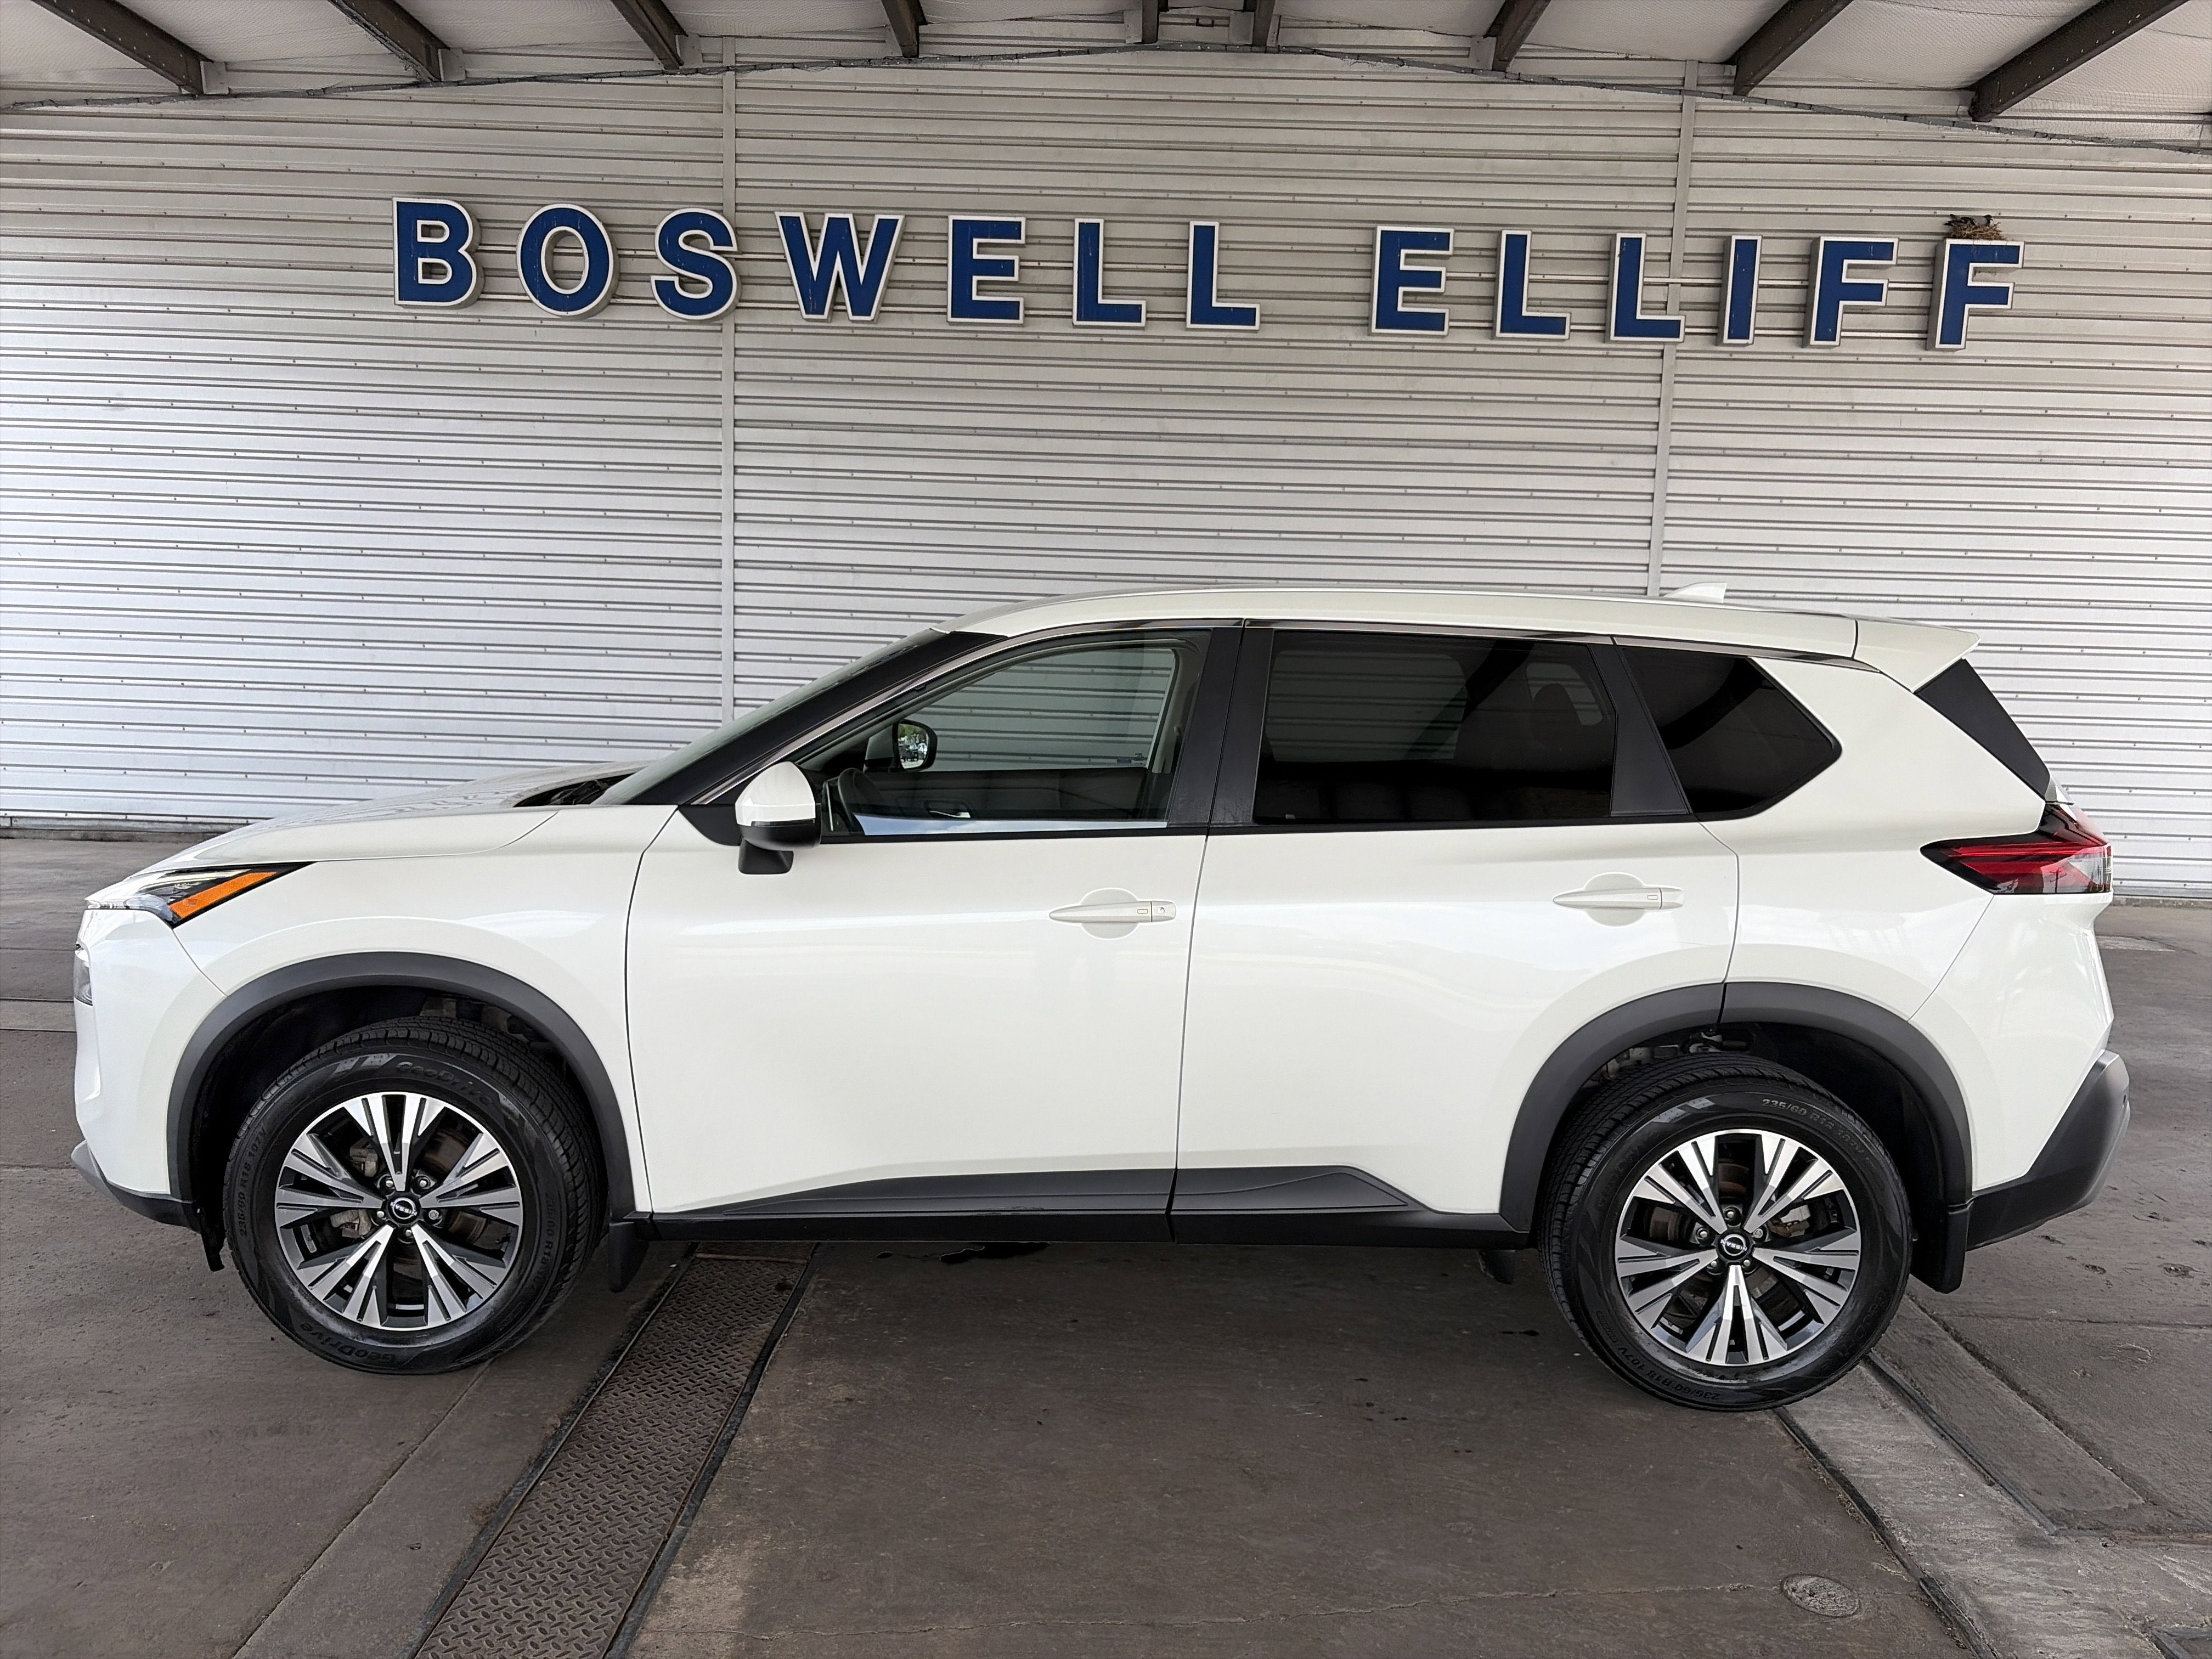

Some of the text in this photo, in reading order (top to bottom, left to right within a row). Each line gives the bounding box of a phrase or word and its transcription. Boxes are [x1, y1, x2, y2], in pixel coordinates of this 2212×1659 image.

[393, 197, 2025, 349] BOSWELL ELLIFF
[395, 1061, 494, 1108] GeoDrive
[1760, 1098, 1808, 1117] 235/60
[239, 1161, 252, 1188] R18
[237, 1191, 247, 1238] 235/60
[390, 1201, 417, 1216] NISSAN
[1720, 1239, 1748, 1251] NISSAN
[298, 1320, 396, 1365] GeoDrive
[1616, 1344, 1646, 1371] 107V
[1645, 1368, 1672, 1387] R18
[1673, 1382, 1720, 1400] 235/60
